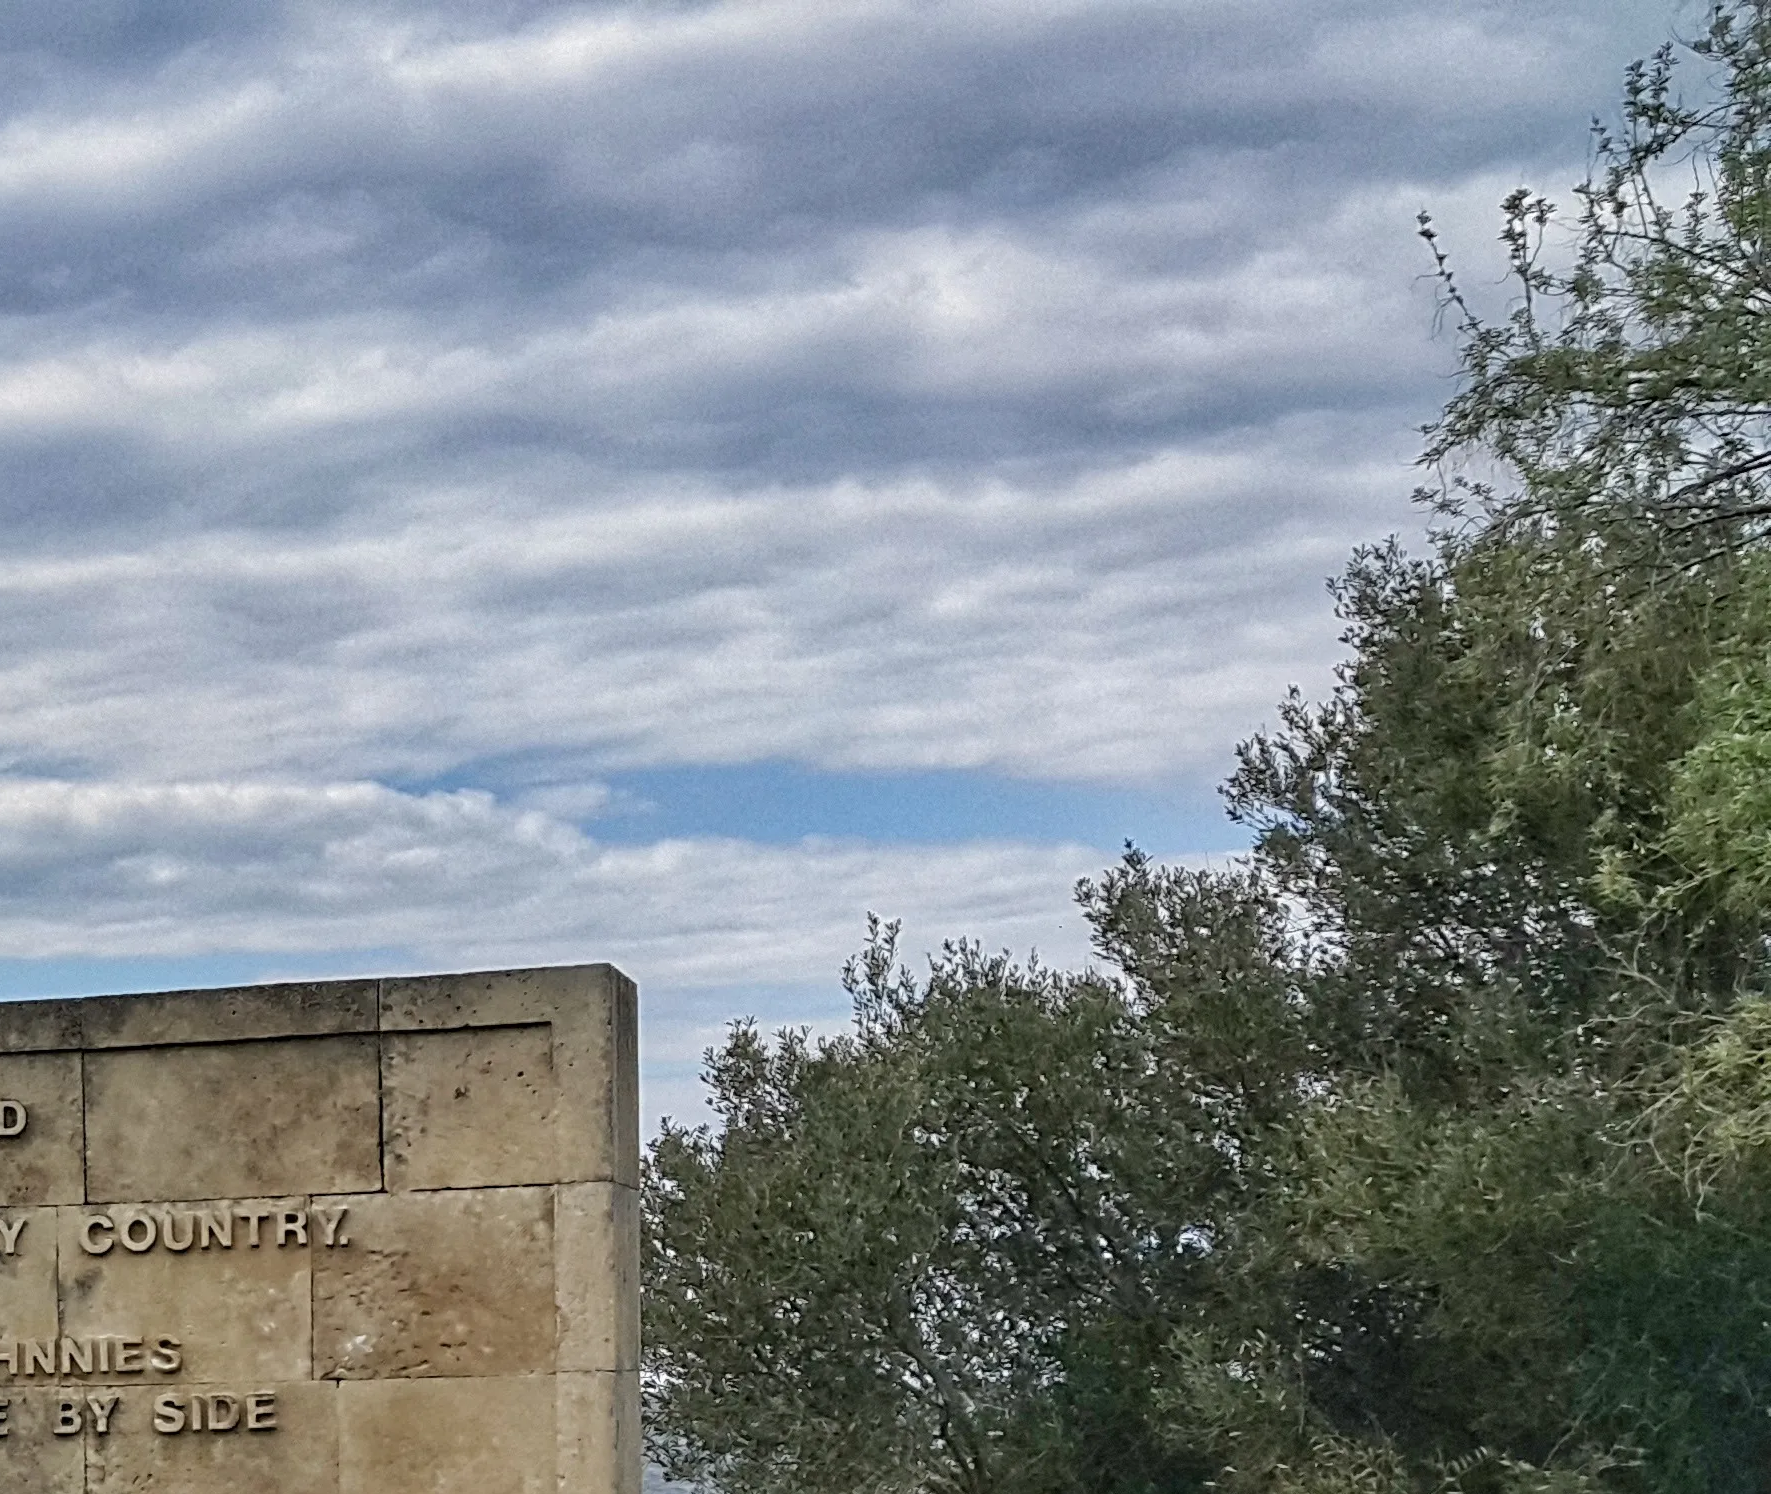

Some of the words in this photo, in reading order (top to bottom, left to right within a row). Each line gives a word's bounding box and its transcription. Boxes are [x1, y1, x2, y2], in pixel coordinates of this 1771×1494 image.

[78, 1208, 352, 1255] COUNTRY.
[53, 1393, 121, 1434] BY
[153, 1390, 278, 1434] SIDE
